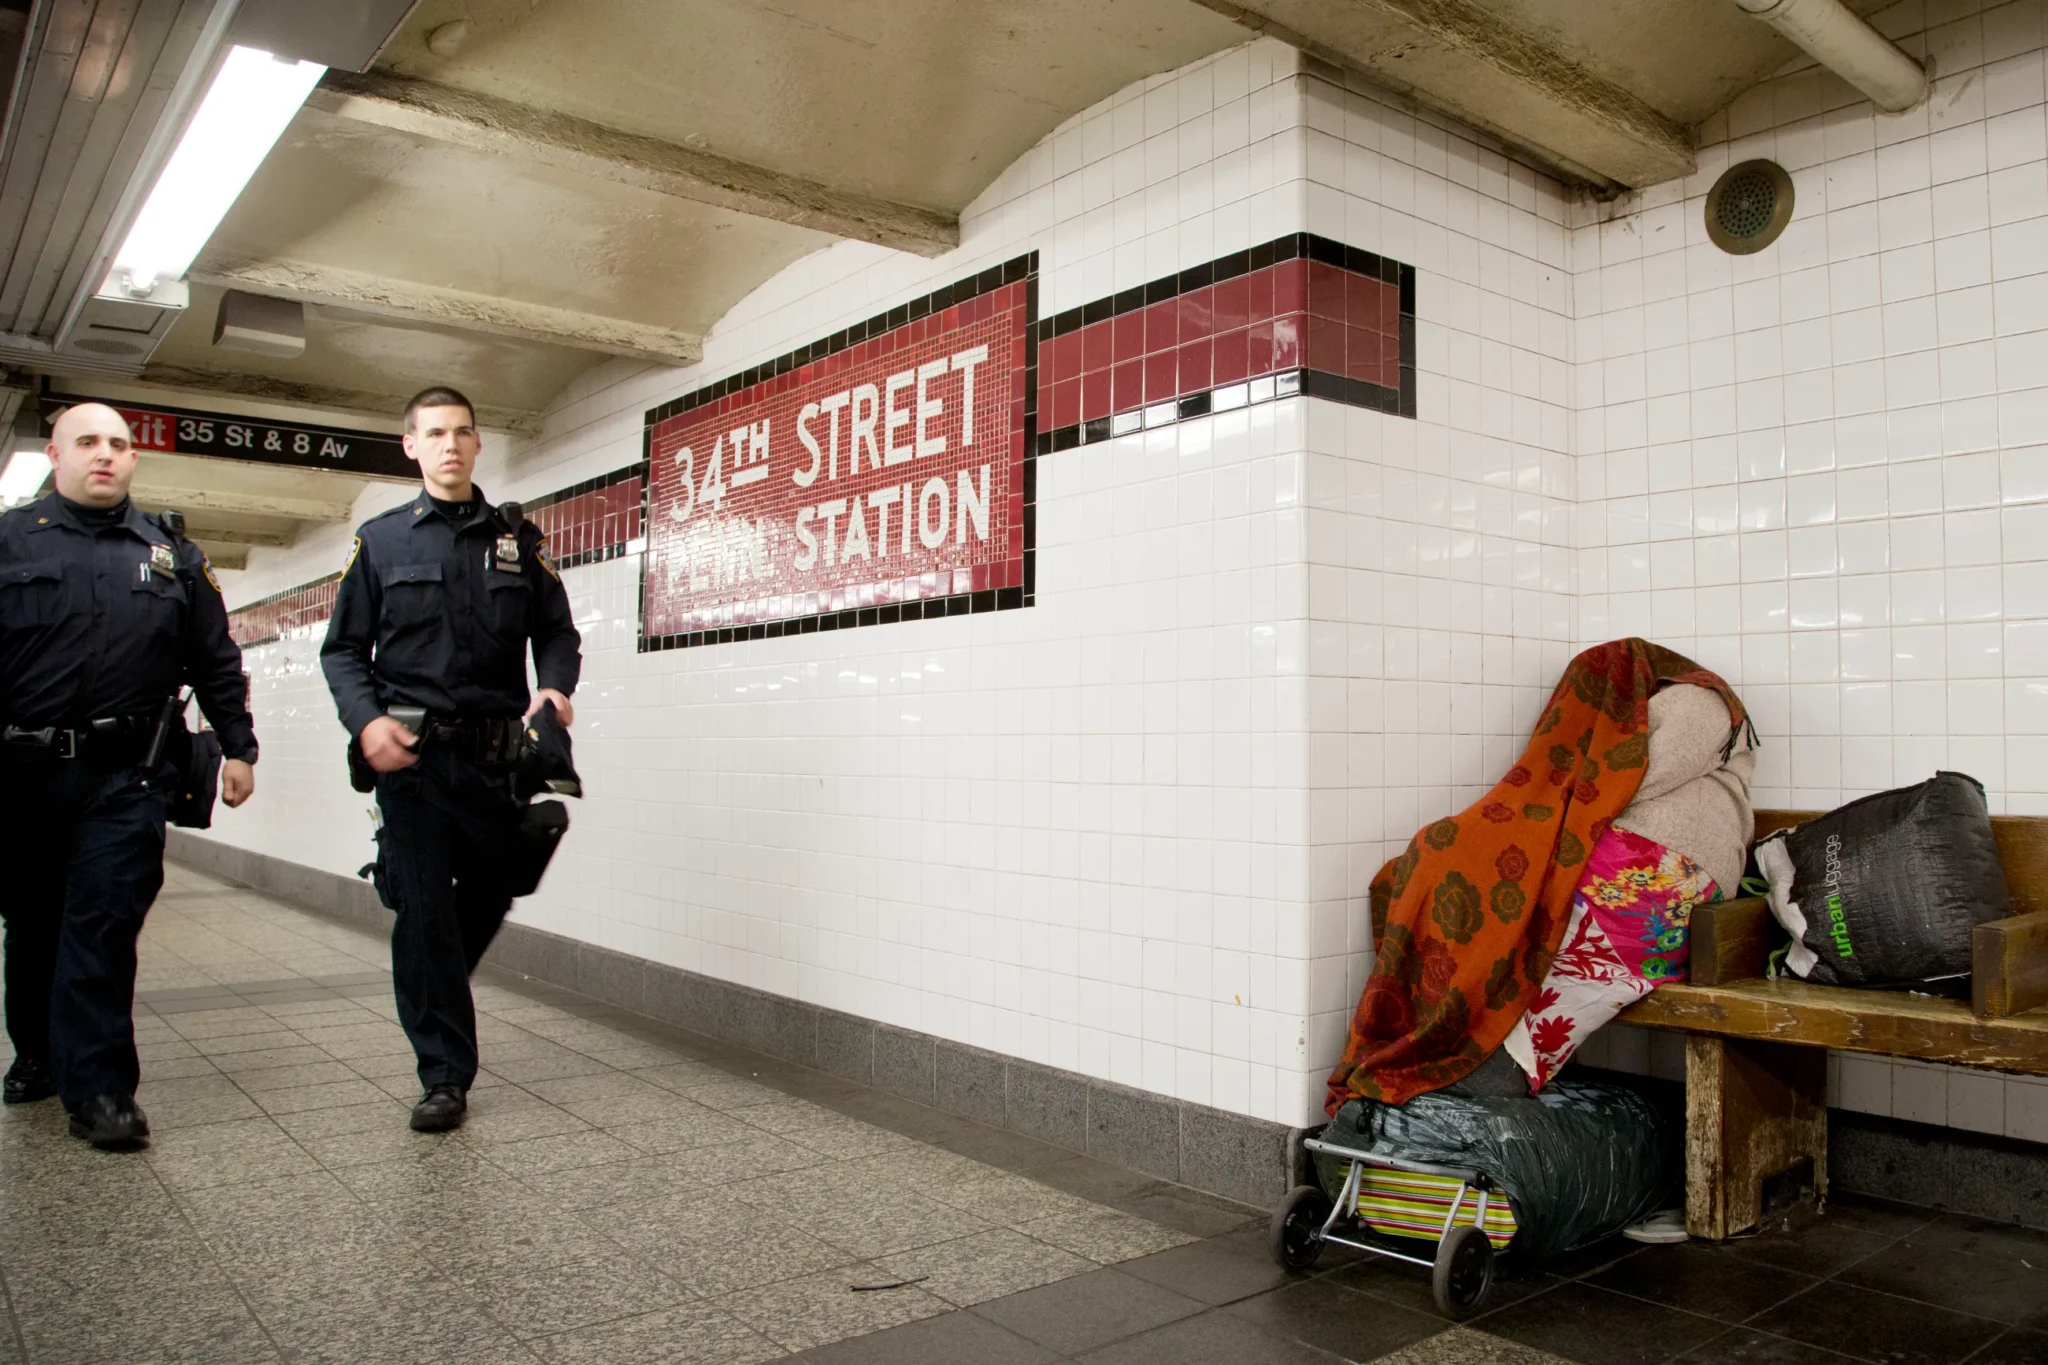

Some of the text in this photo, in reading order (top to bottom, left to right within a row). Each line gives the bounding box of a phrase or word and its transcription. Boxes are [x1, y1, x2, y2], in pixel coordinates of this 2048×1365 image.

[129, 415, 349, 459] xit 35 St & 8 Av
[669, 345, 989, 522] 34TH STREET
[793, 464, 991, 571] STATION
